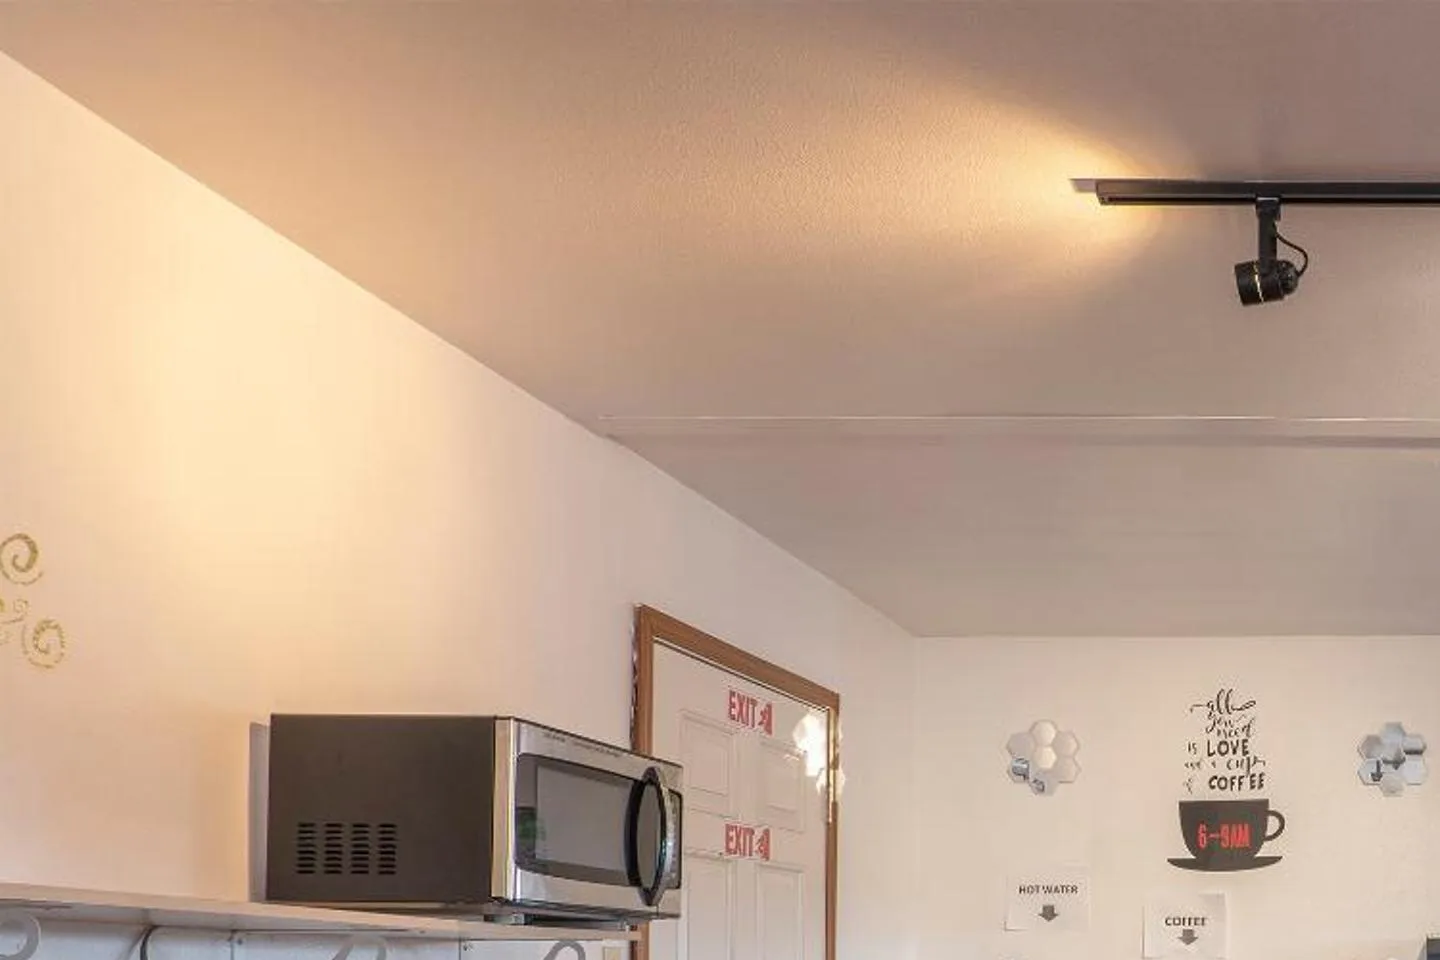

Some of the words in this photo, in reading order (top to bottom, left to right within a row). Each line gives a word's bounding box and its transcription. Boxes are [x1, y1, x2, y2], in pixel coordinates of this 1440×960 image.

[728, 690, 758, 729] EXIT
[1206, 738, 1249, 757] LOVE
[1208, 772, 1266, 792] COFFEE
[724, 823, 755, 857] EXIT
[1018, 884, 1040, 895] HOT
[1041, 884, 1079, 895] WATER
[1164, 915, 1208, 927] COFFEE
